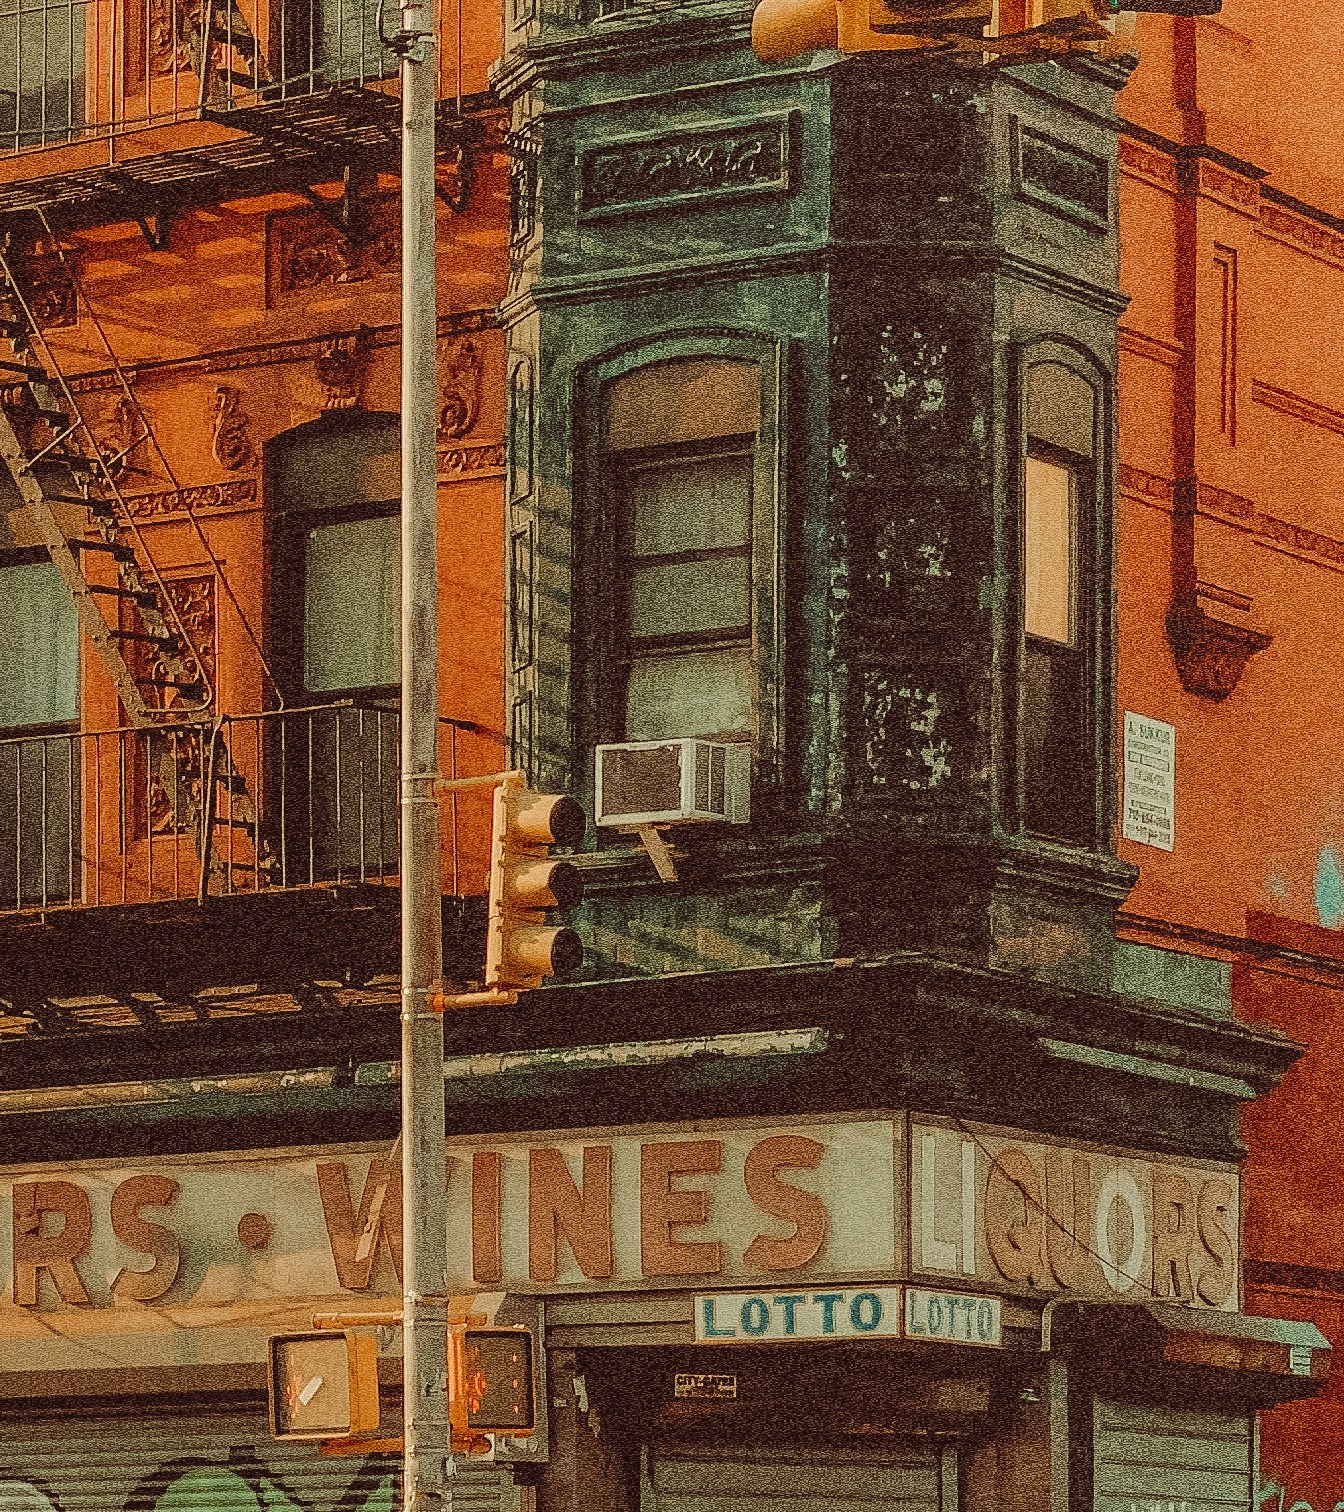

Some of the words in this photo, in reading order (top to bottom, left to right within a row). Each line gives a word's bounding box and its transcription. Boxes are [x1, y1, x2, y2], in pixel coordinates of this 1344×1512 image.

[315, 1134, 827, 1289] WINES
[922, 1133, 1232, 1307] LIQUORS
[703, 1291, 884, 1338] LOTTO
[913, 1293, 995, 1343] LOTTO
